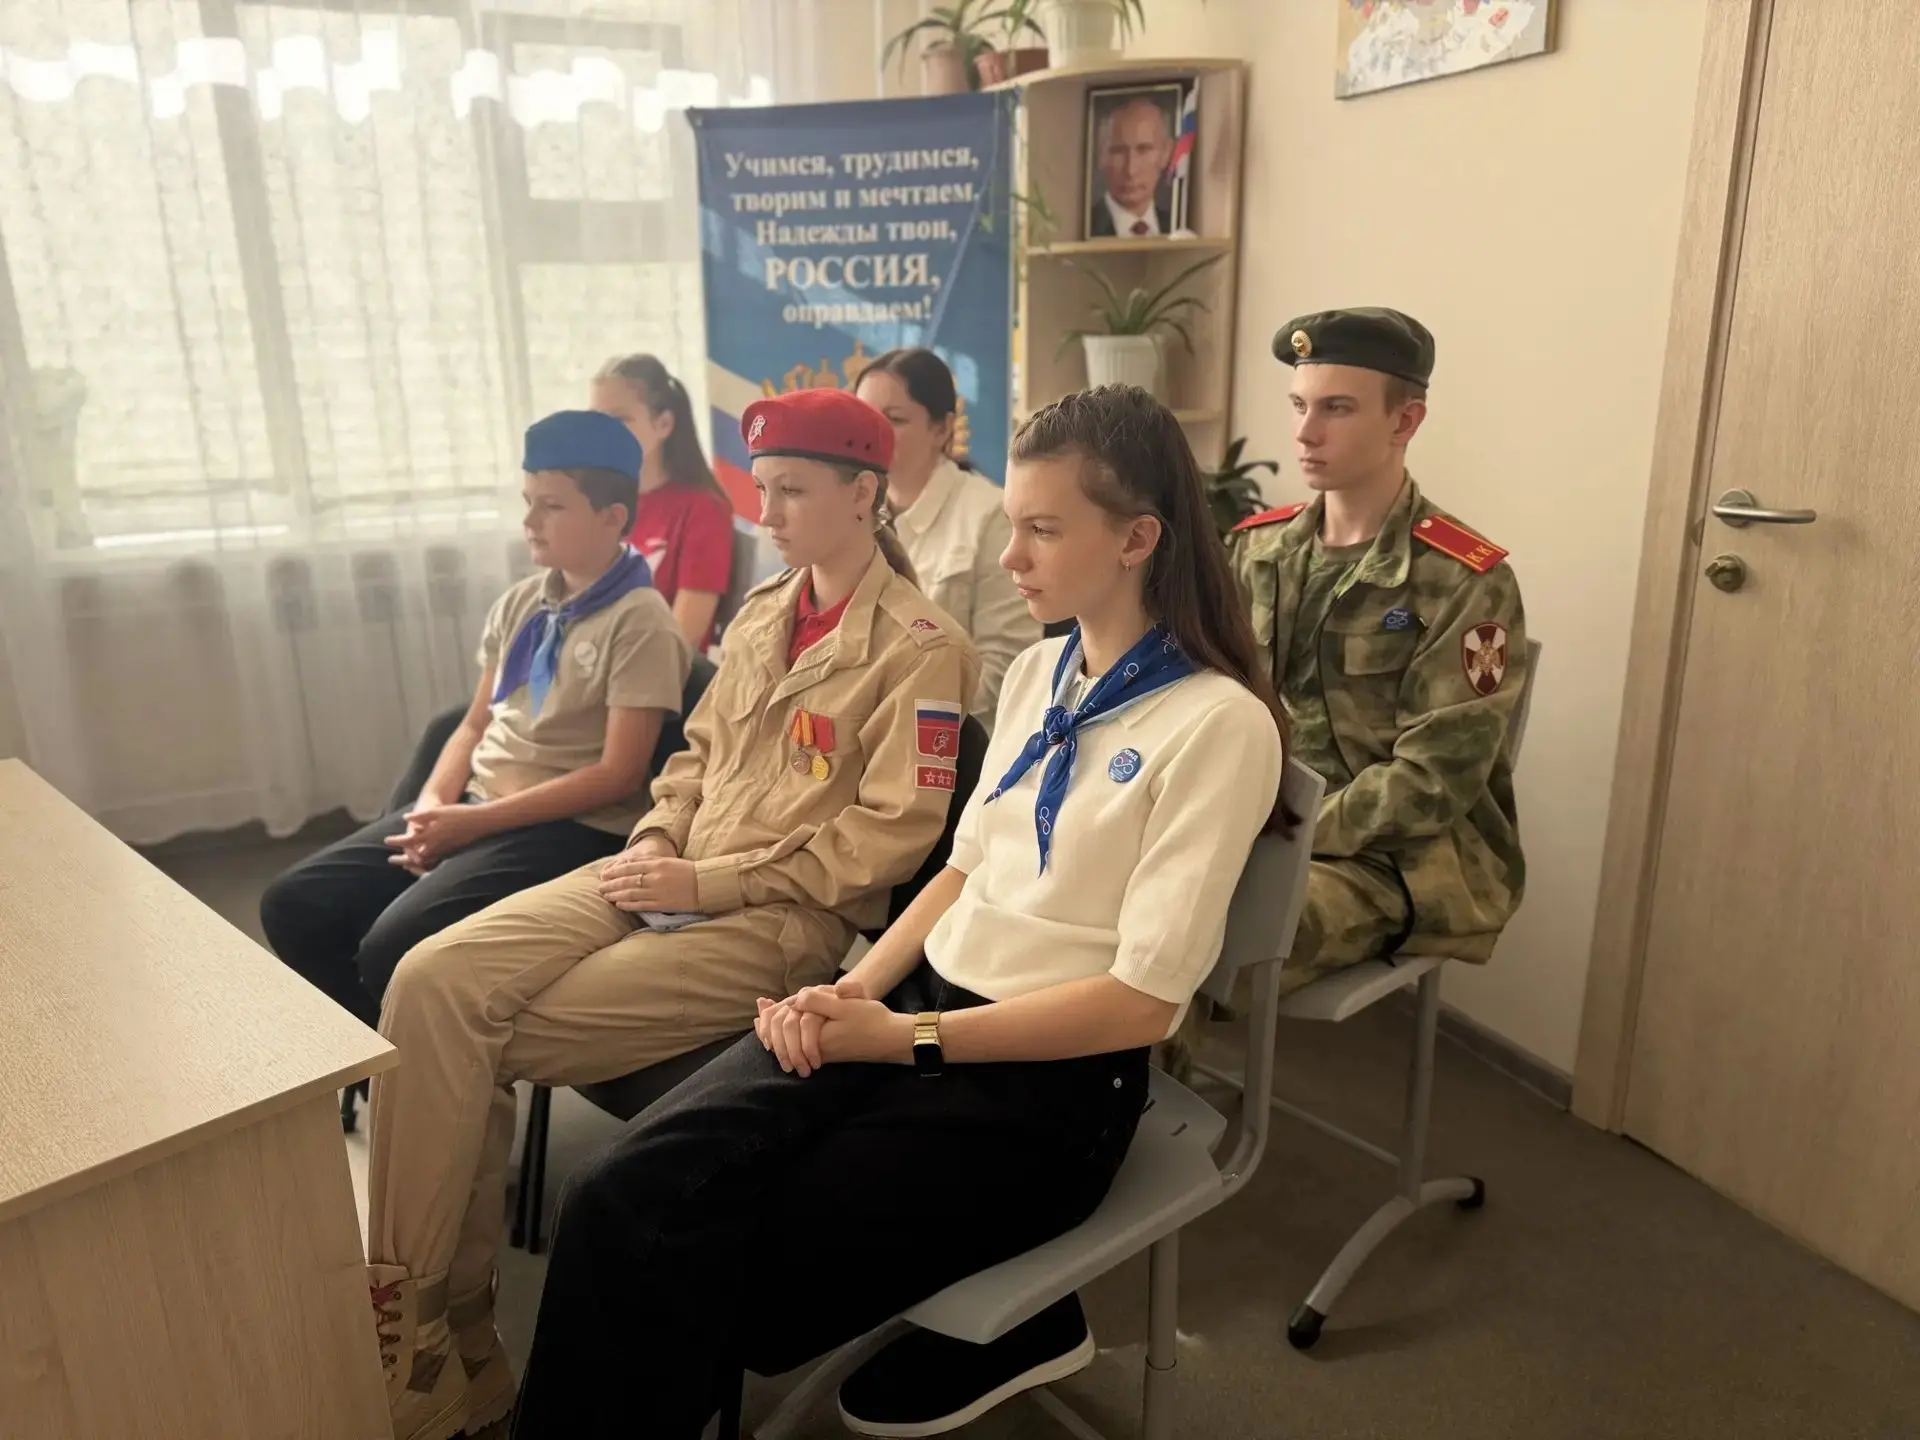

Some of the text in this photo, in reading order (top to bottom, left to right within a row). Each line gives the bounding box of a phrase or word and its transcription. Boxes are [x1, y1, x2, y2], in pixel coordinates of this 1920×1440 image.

[724, 147, 979, 179] Учимся, трудимся,
[731, 190, 827, 217] творим
[834, 190, 851, 208] и
[756, 220, 958, 246] Надежды твои,
[765, 253, 941, 291] РОССИЯ,
[782, 294, 932, 329] оправдаем!
